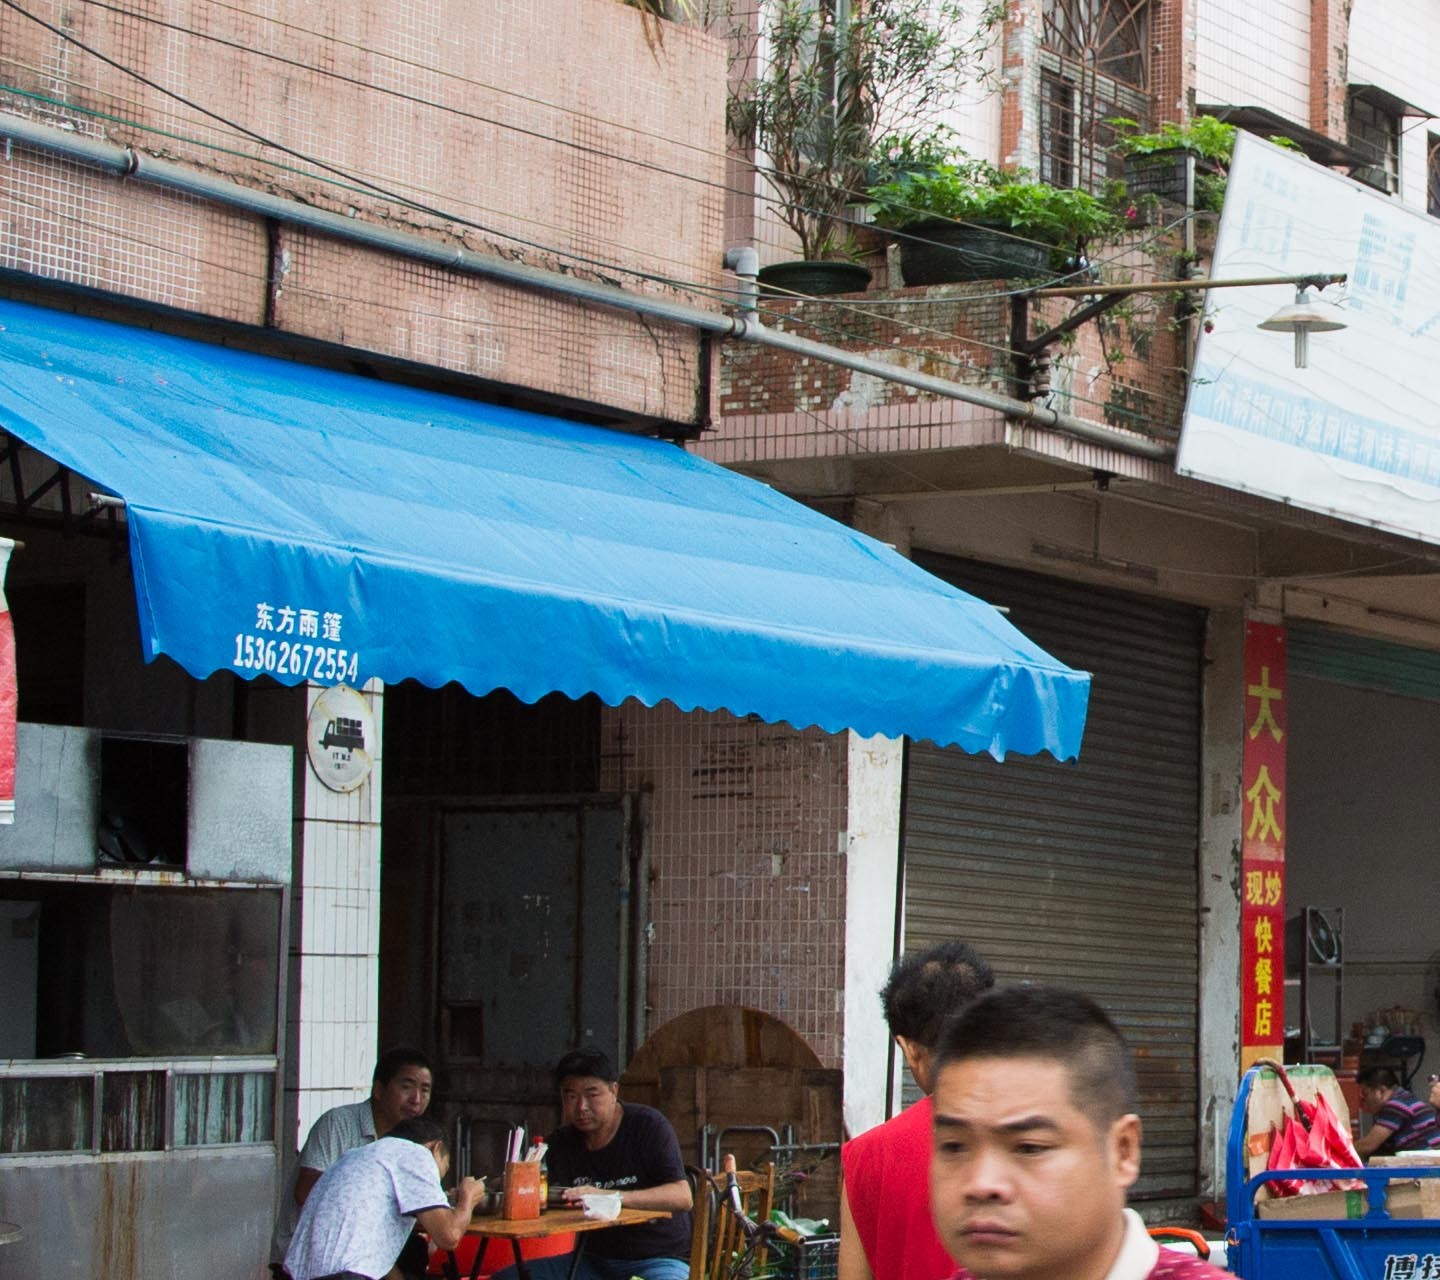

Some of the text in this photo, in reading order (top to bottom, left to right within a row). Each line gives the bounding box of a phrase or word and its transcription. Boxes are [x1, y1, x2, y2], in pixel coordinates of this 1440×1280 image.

[255, 601, 342, 642] 东方雨篷
[233, 633, 359, 683] 15362672554
[1245, 666, 1284, 1038] 大众 现炒 快餐店
